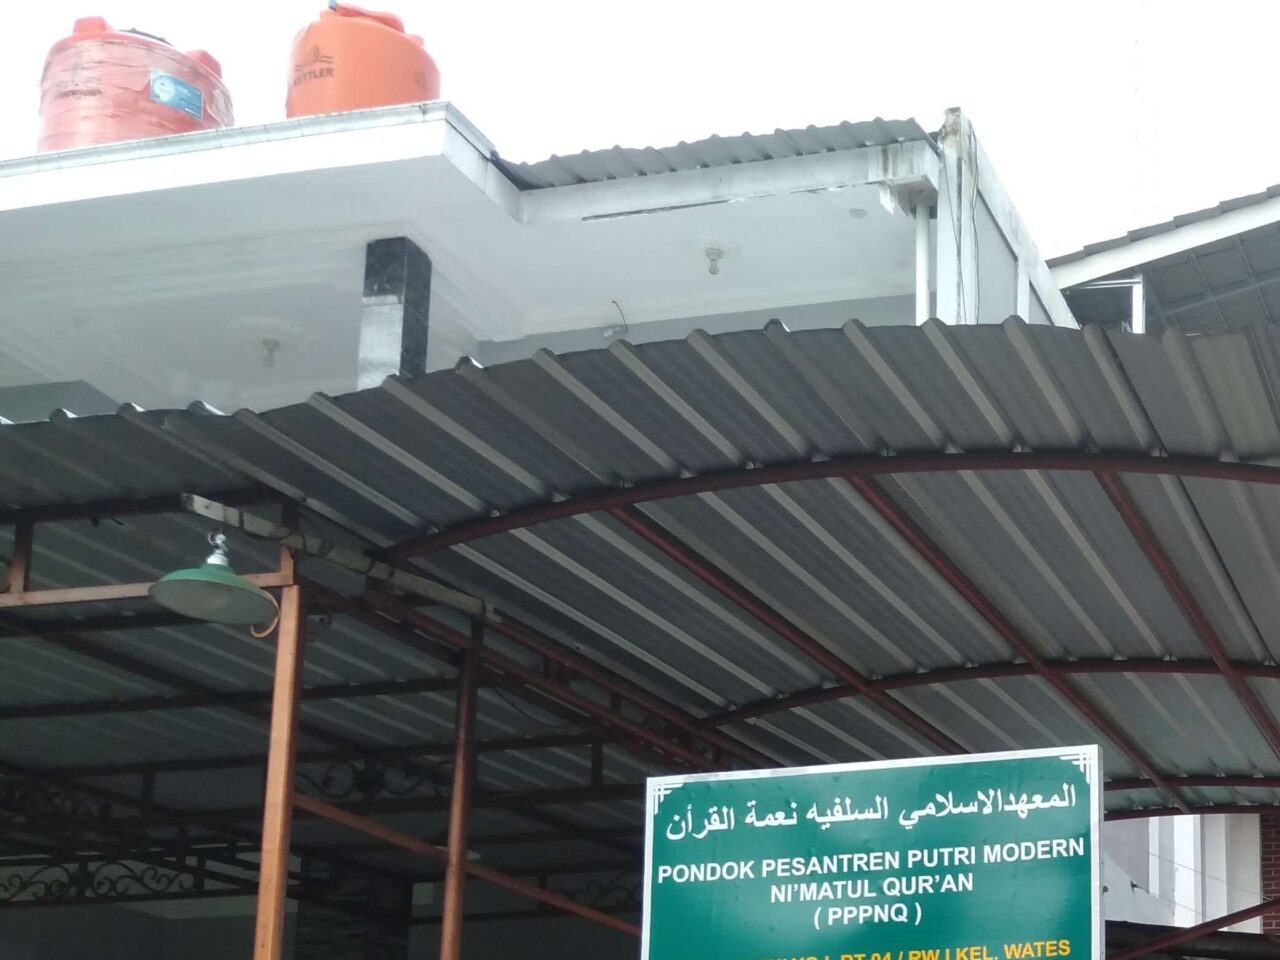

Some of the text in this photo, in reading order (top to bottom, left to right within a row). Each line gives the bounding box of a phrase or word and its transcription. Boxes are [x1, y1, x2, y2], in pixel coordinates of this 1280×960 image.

[666, 803, 735, 841] القرأن
[744, 799, 798, 828] نعمة
[658, 837, 1084, 884] PONDOK PESANTREN PUTRI MODERN
[770, 872, 974, 904] NI'MATUL QUR'AN
[1003, 939, 1071, 960] WATES
